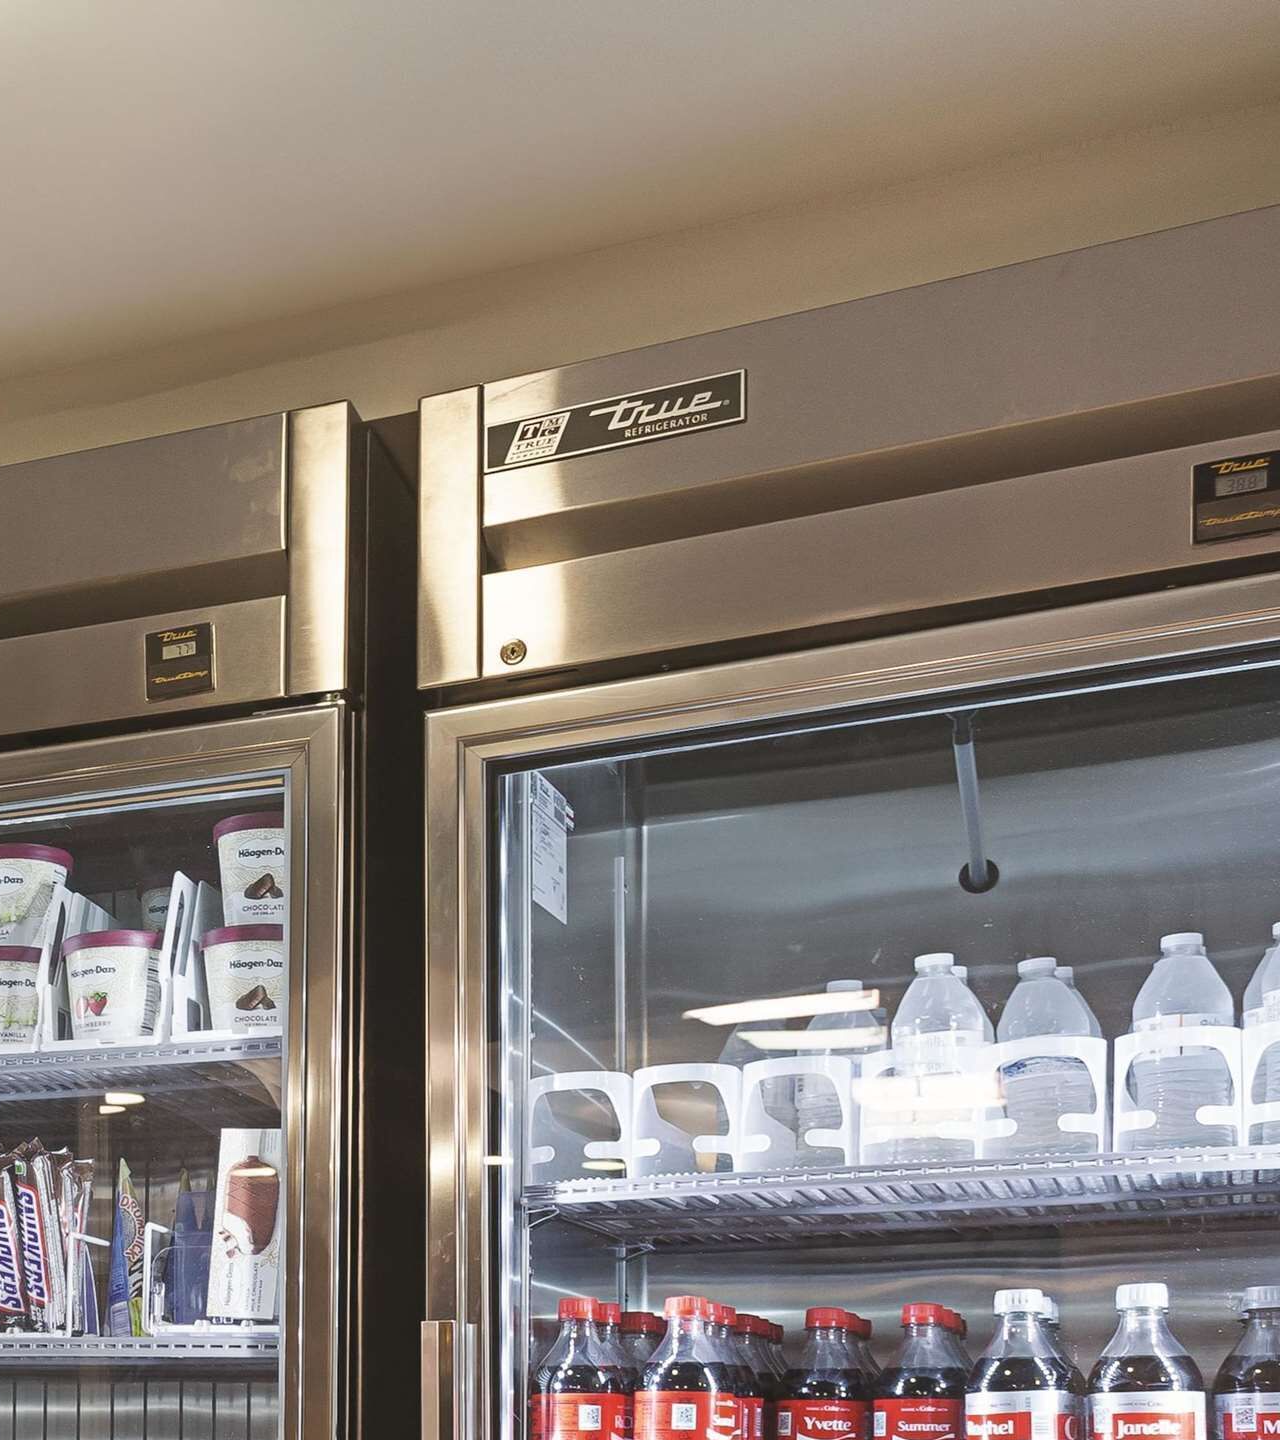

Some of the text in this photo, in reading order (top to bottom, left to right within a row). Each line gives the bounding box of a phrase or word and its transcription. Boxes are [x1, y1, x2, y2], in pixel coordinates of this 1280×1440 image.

[624, 413, 708, 438] REFRIGERATOR
[234, 1015, 277, 1023] CHOCOLATE
[0, 1031, 27, 1039] VANILLA
[18, 1191, 45, 1298] SNICKERS
[803, 1416, 852, 1431] Yvette
[897, 1420, 951, 1432] Summer
[1116, 1419, 1183, 1440] Janelle
